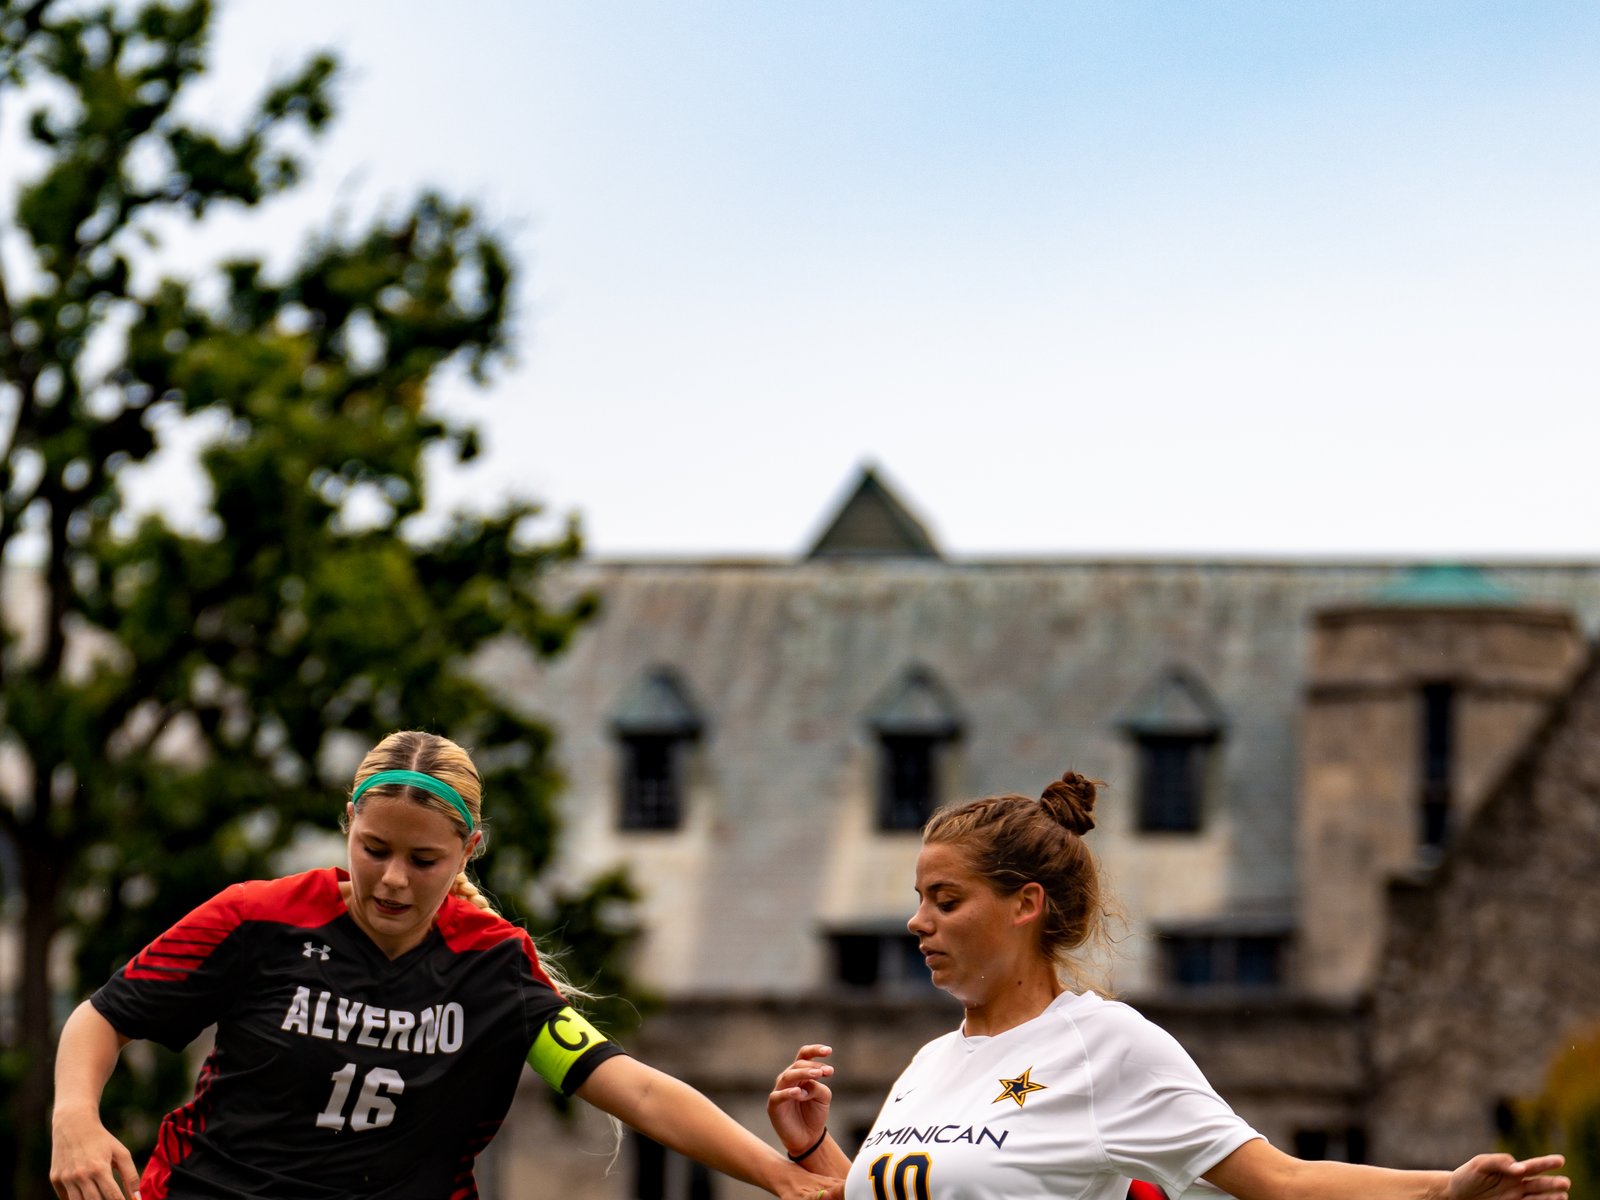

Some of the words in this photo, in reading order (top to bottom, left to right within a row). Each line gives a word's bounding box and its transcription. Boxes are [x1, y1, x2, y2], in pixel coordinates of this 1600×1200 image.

[281, 985, 464, 1054] ALVERNO
[548, 1014, 589, 1051] C
[316, 1063, 405, 1132] 16
[865, 1124, 1009, 1150] OMINICAN
